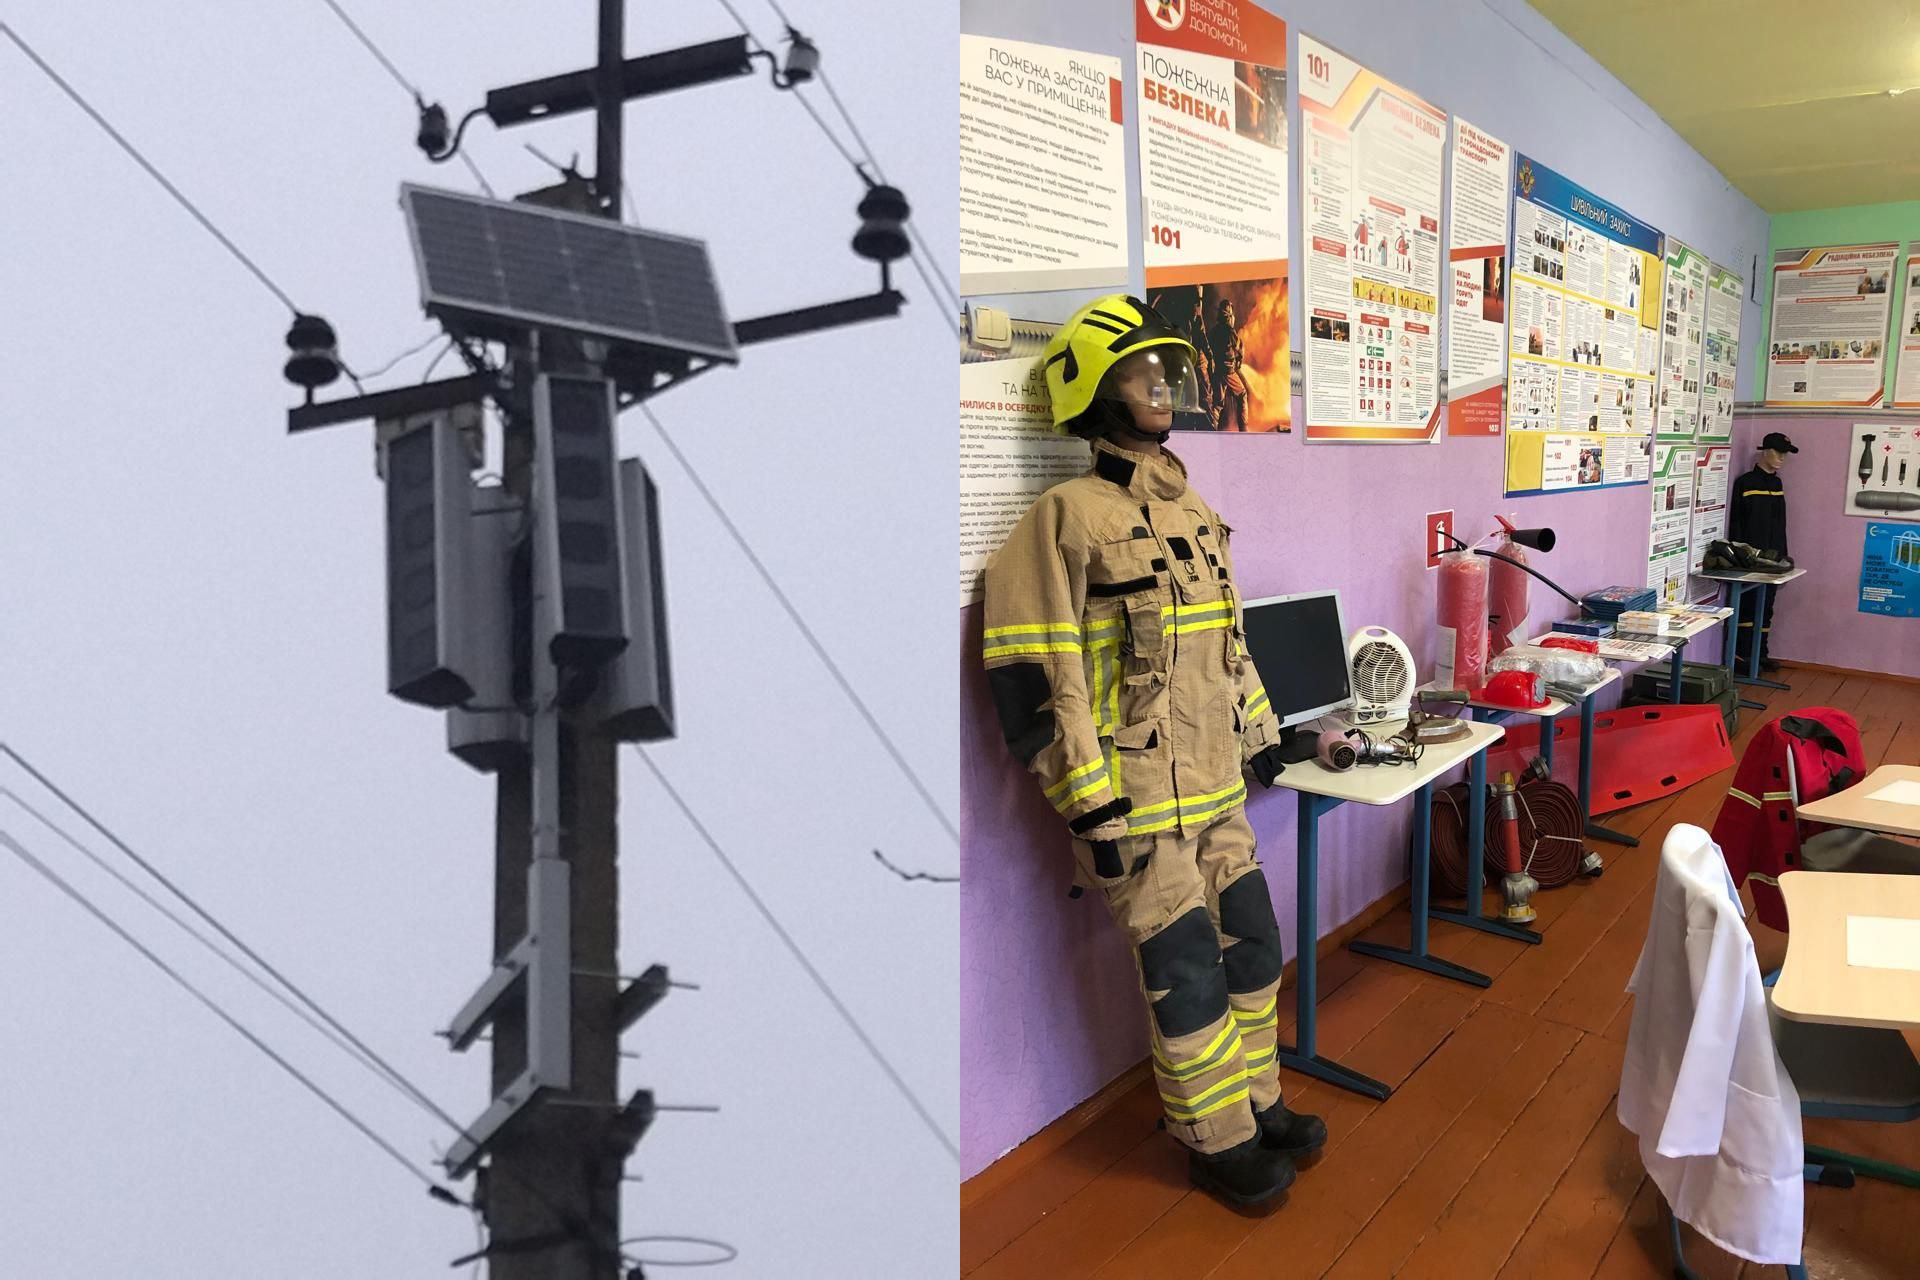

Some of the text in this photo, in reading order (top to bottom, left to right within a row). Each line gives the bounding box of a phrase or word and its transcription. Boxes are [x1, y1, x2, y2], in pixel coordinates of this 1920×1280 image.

[1190, 0, 1240, 37] ВРЯТУВАТИ,
[1190, 16, 1248, 54] ДОПОМОГТИ
[990, 48, 1106, 102] ПОЖЕЖА ЗАСТАЛА
[1069, 60, 1106, 86] ЯКЩО
[1144, 51, 1230, 106] ПОЖЕЖНА
[1307, 54, 1329, 82] 101
[986, 65, 1106, 120] ВАС У ПРИМІЩЕННІ:
[1144, 77, 1230, 131] БЕЗПЕКА
[1571, 194, 1608, 226] ЦИВІЛЬНИЙ
[1610, 215, 1631, 237] ЗАХИСТ
[1152, 224, 1180, 249] 101
[1828, 251, 1894, 262] РАДІАЦІЙНА НЕБЕЗПЕКА
[1456, 270, 1470, 280] ЯКЩО
[1456, 289, 1473, 299] ГОРИТЬ
[1456, 299, 1468, 308] ОДЯГ
[1030, 369, 1036, 380] В
[1002, 382, 1017, 395] ТА
[1022, 384, 1037, 397] НА
[960, 400, 995, 410] НИЛИСЯ
[1005, 403, 1045, 414] ОСЕРЕДКУ
